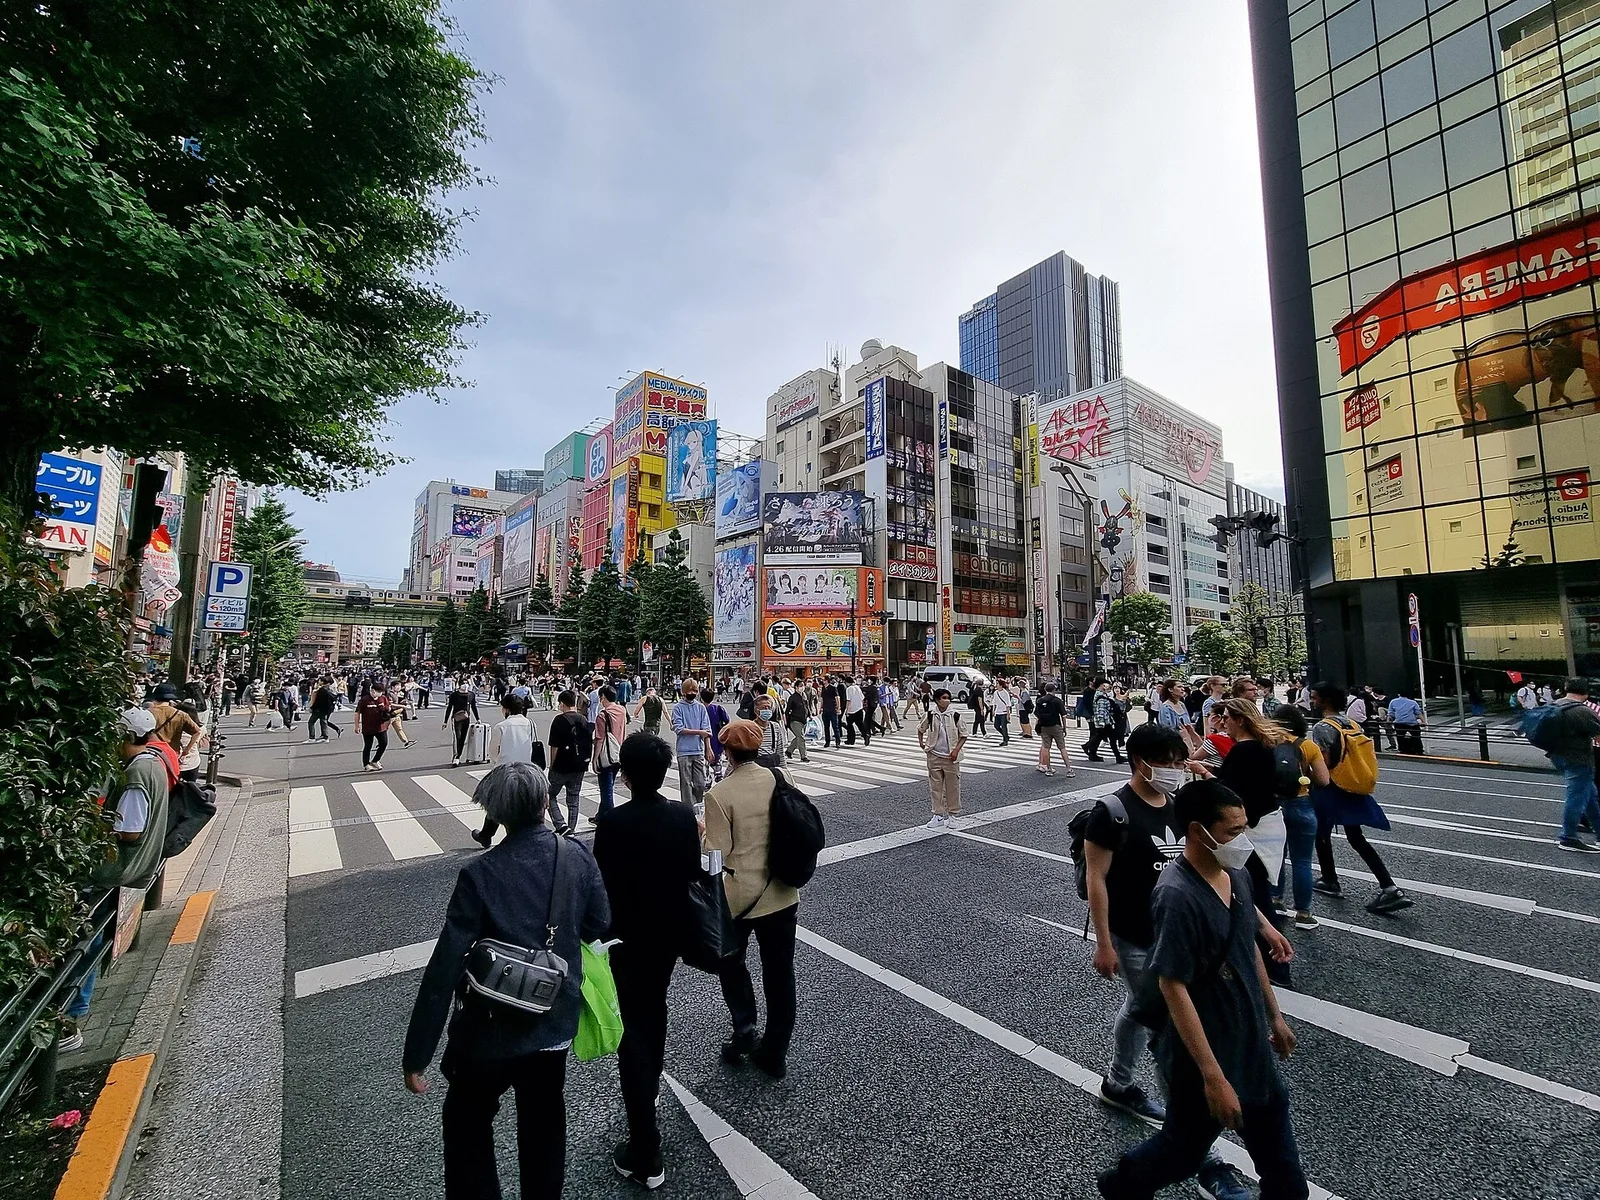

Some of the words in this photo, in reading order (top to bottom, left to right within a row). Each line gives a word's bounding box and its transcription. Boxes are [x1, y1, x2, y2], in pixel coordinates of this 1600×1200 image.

[1042, 395, 1108, 434] AKIBA
[1042, 417, 1110, 448] カルチャーズ
[896, 460, 905, 469] 7F
[766, 545, 784, 553] 4.26
[216, 567, 243, 592] P
[771, 625, 797, 651] 質
